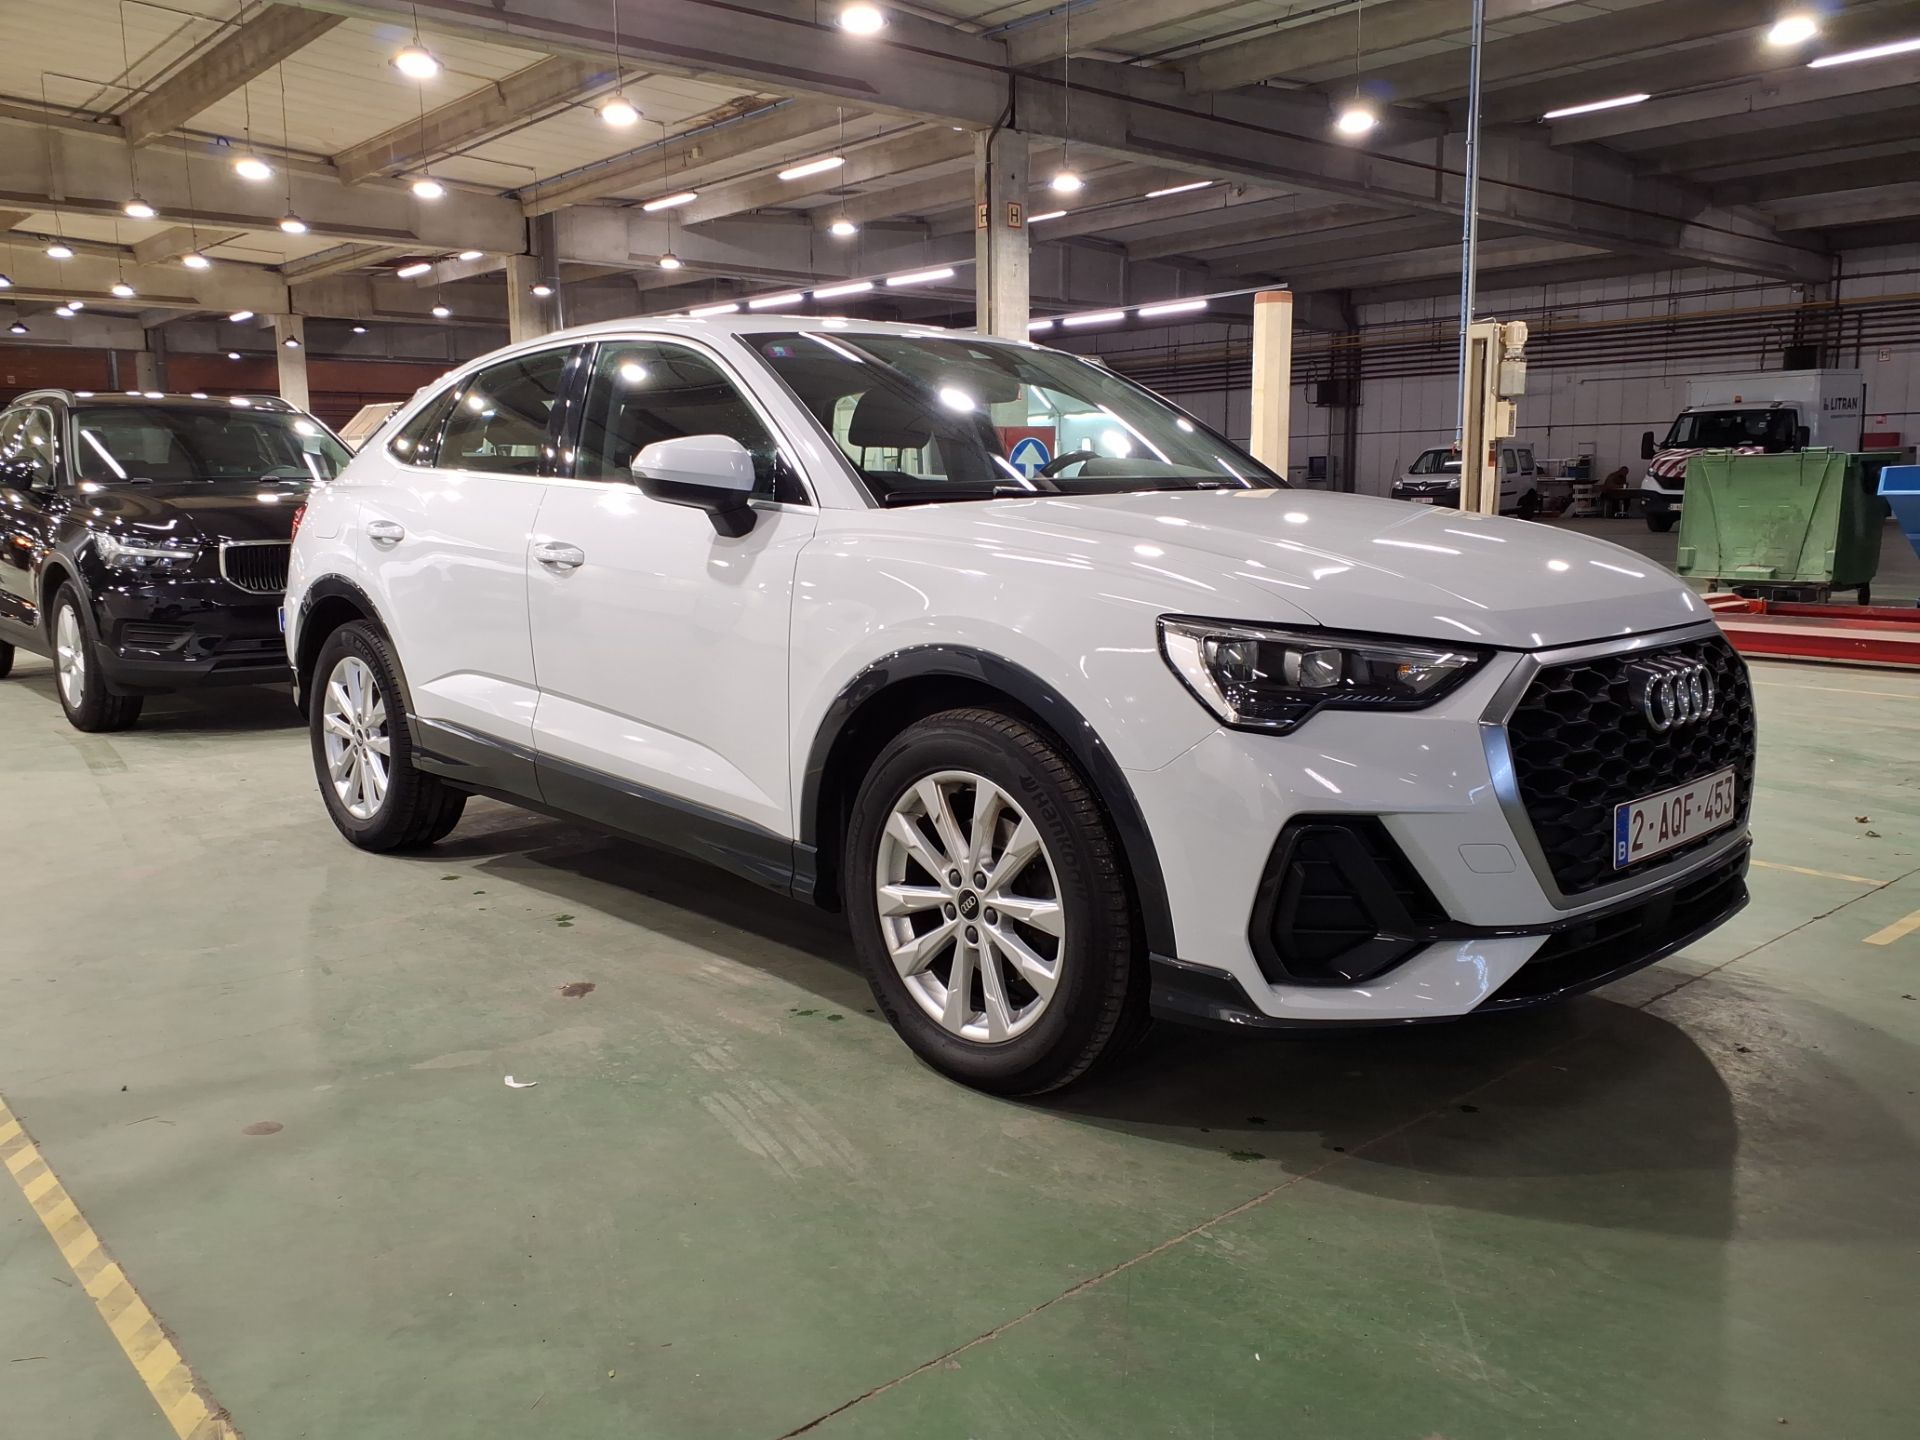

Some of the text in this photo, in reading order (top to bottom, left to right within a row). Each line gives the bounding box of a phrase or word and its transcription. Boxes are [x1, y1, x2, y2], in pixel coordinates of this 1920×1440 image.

[1010, 207, 1018, 223] H
[1831, 397, 1858, 410] LITRAN
[1618, 841, 1626, 860] B
